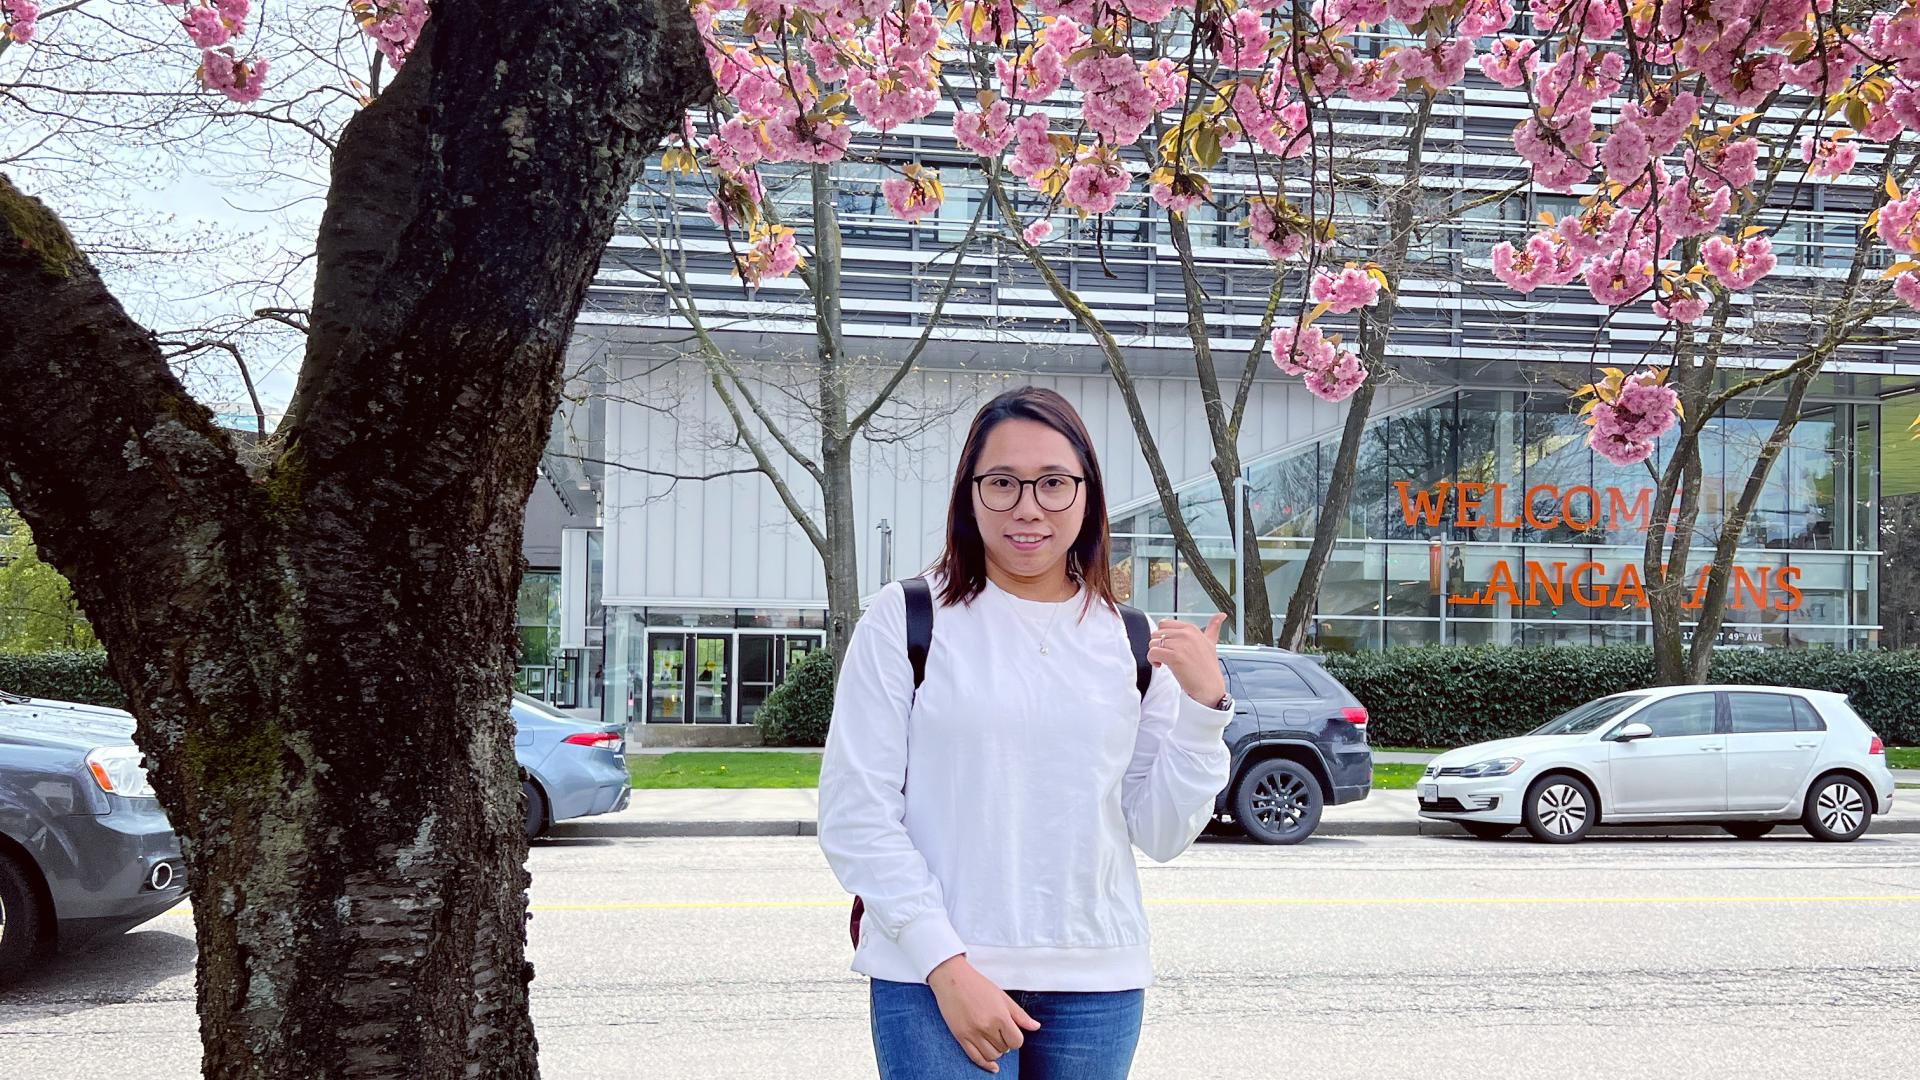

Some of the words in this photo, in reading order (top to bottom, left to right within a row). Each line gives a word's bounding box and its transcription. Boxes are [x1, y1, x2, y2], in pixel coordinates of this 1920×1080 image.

[1394, 481, 1683, 533] WELCOM
[1448, 560, 1803, 611] ANGAANS
[1746, 633, 1763, 642] AVE
